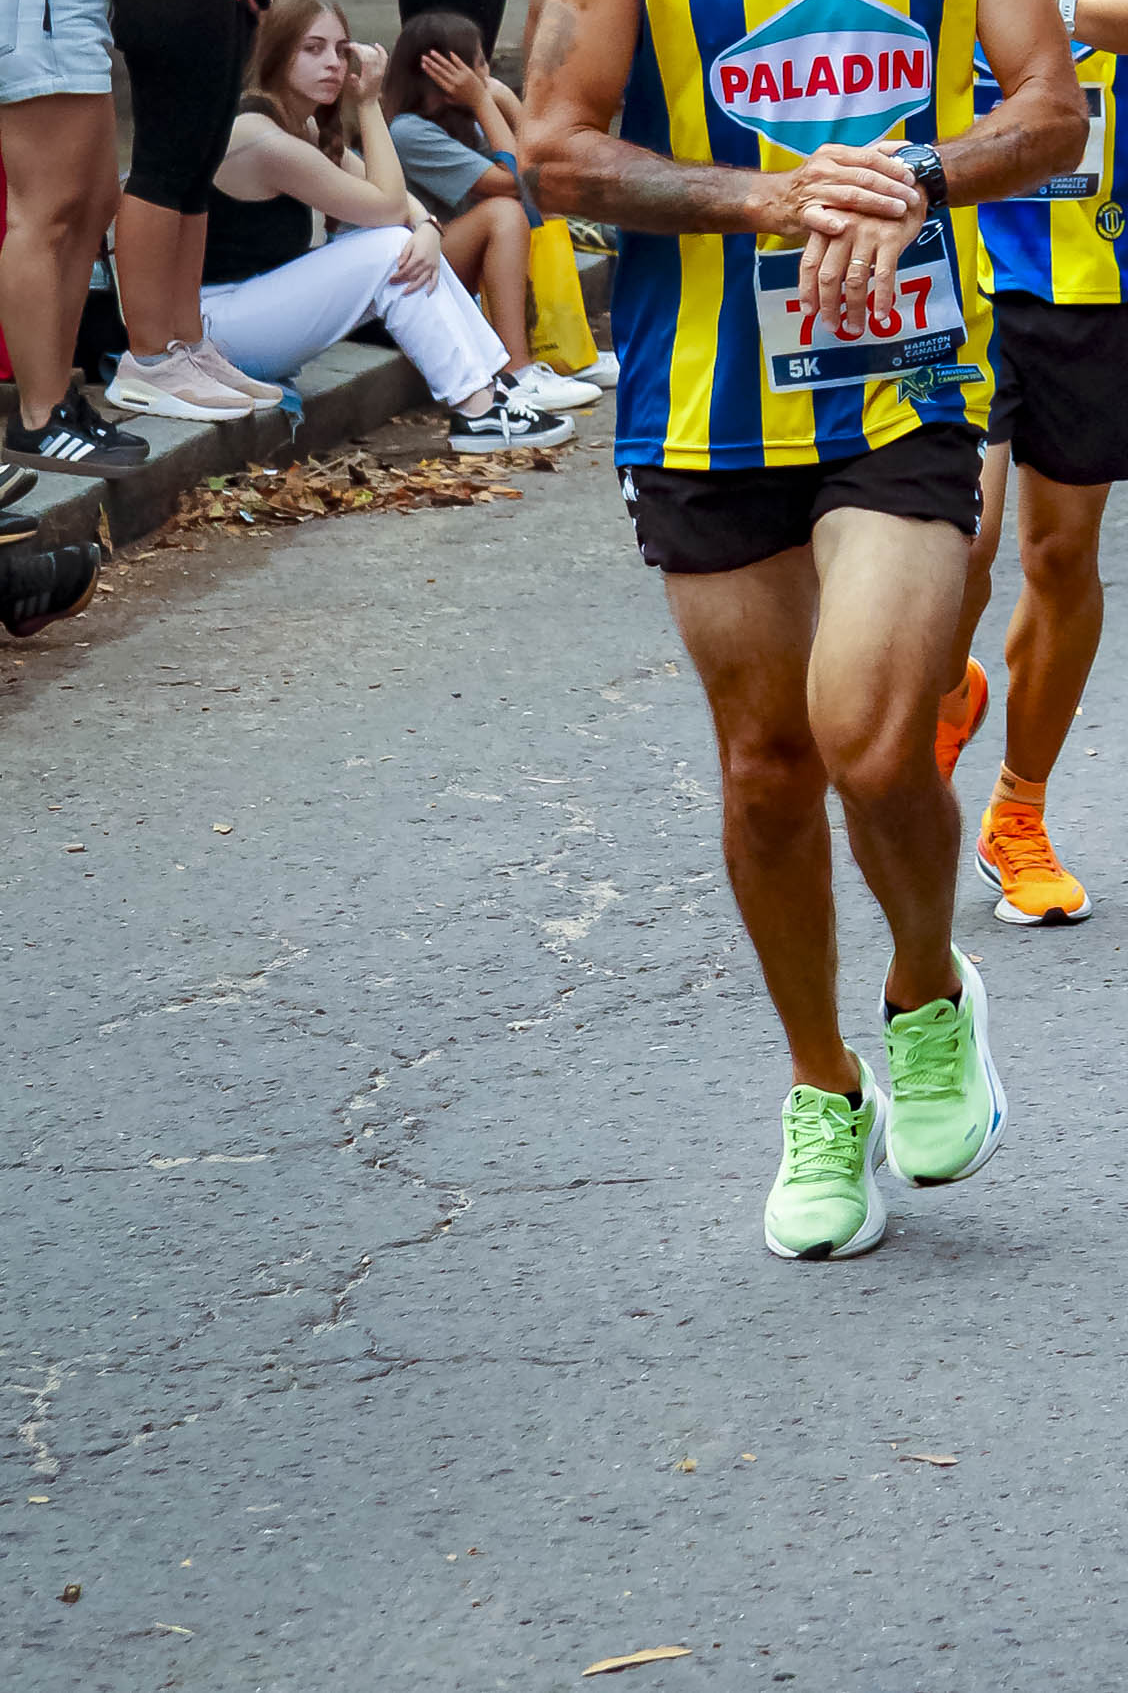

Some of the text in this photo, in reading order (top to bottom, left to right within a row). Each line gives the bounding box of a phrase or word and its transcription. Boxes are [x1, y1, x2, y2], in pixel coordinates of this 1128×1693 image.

[719, 49, 930, 104] PALADIN
[904, 343, 952, 358] CANALLA
[788, 357, 821, 378] 5K
